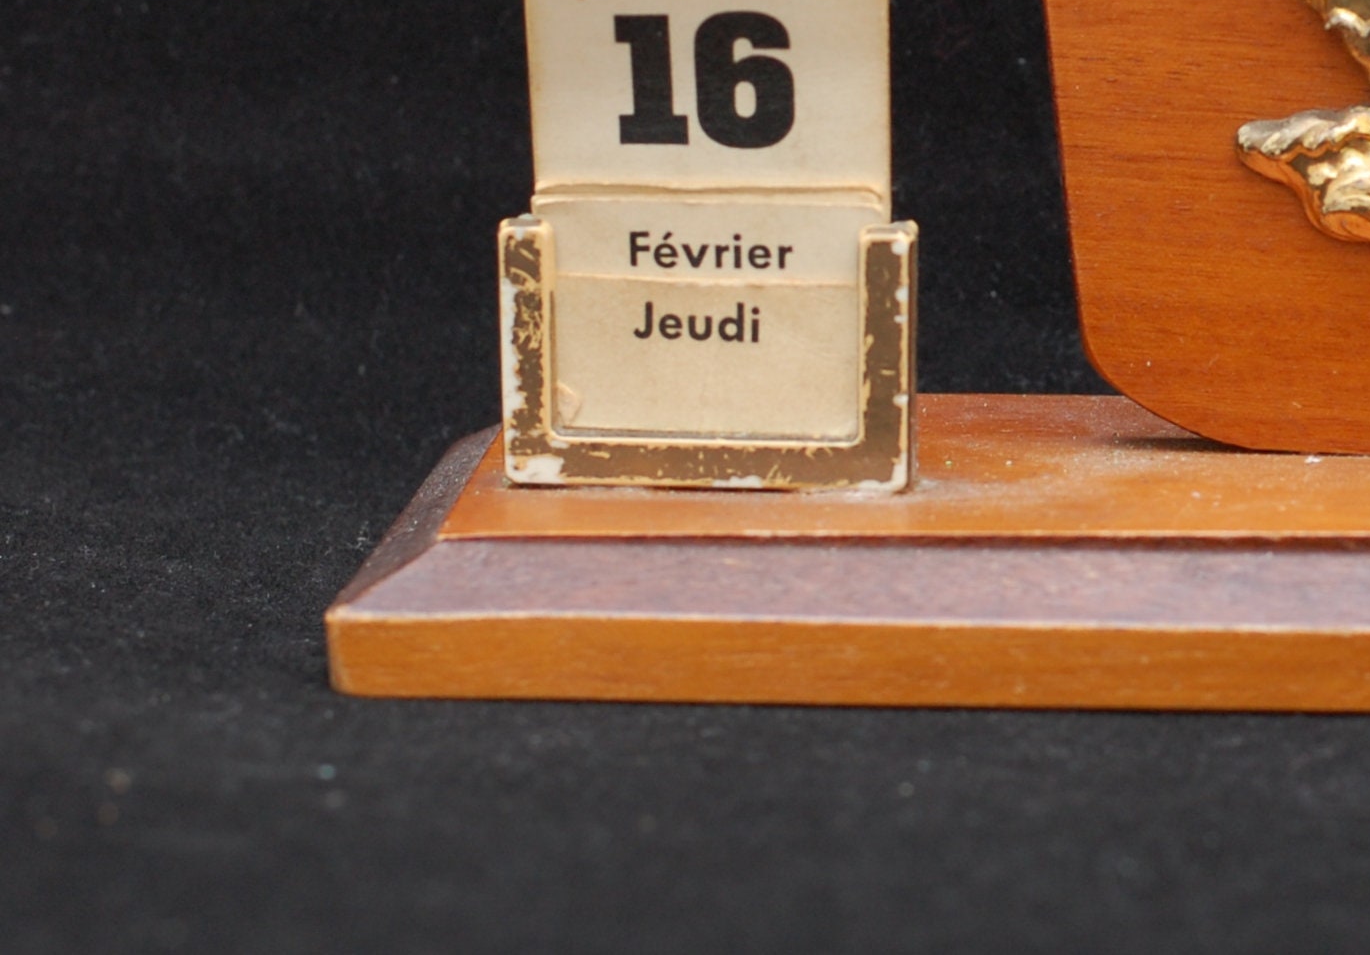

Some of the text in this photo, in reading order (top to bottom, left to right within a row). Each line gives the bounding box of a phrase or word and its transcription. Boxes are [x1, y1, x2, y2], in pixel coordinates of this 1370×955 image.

[613, 10, 795, 150] 16
[628, 230, 794, 270] Février
[632, 301, 761, 344] Jeudi
